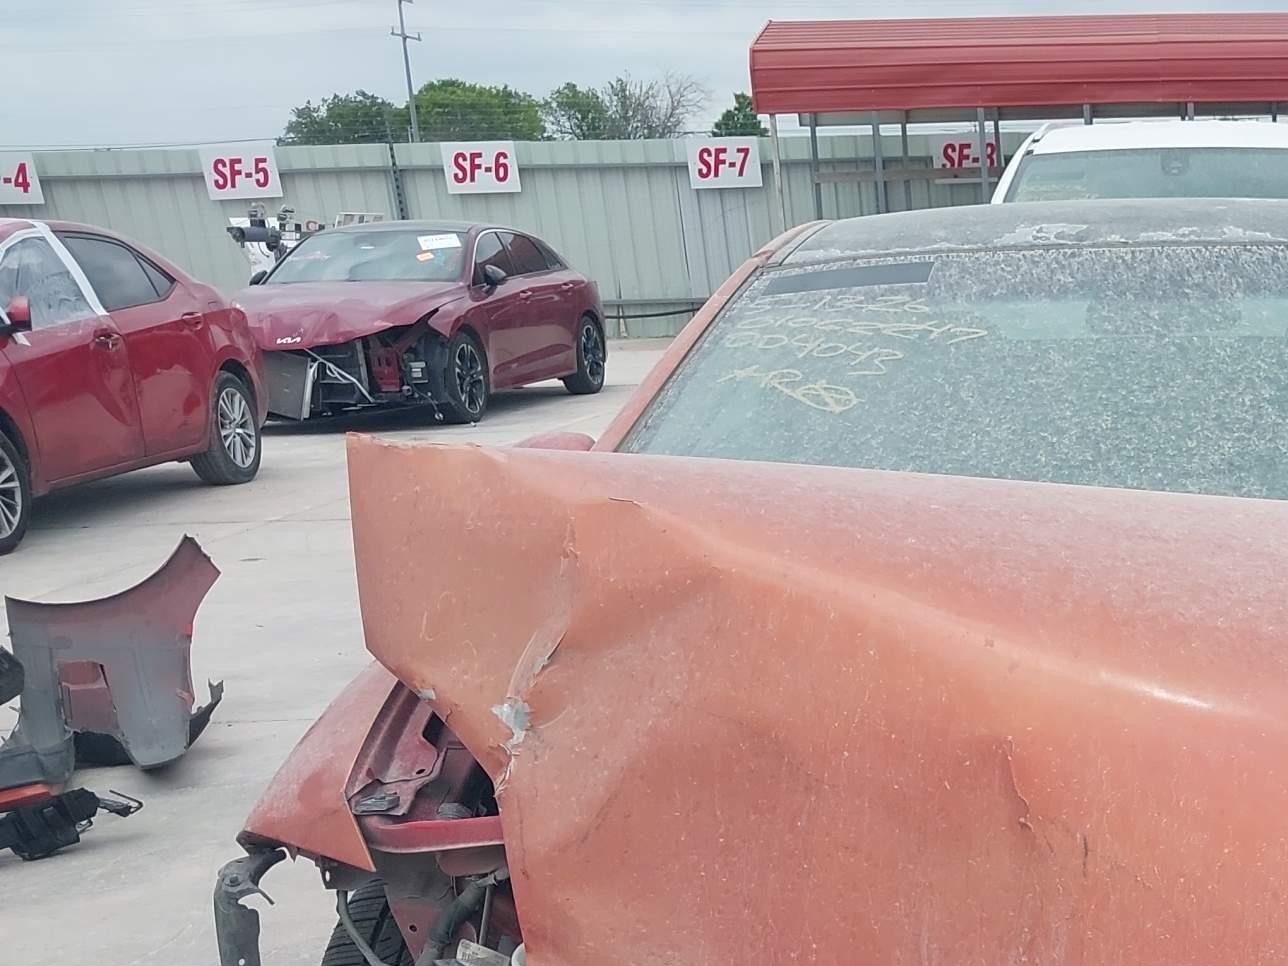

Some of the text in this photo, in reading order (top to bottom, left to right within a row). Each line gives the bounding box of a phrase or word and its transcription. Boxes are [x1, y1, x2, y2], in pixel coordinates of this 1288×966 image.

[212, 157, 270, 190] SF-5
[452, 151, 509, 184] SF-6
[698, 147, 750, 179] SF-7
